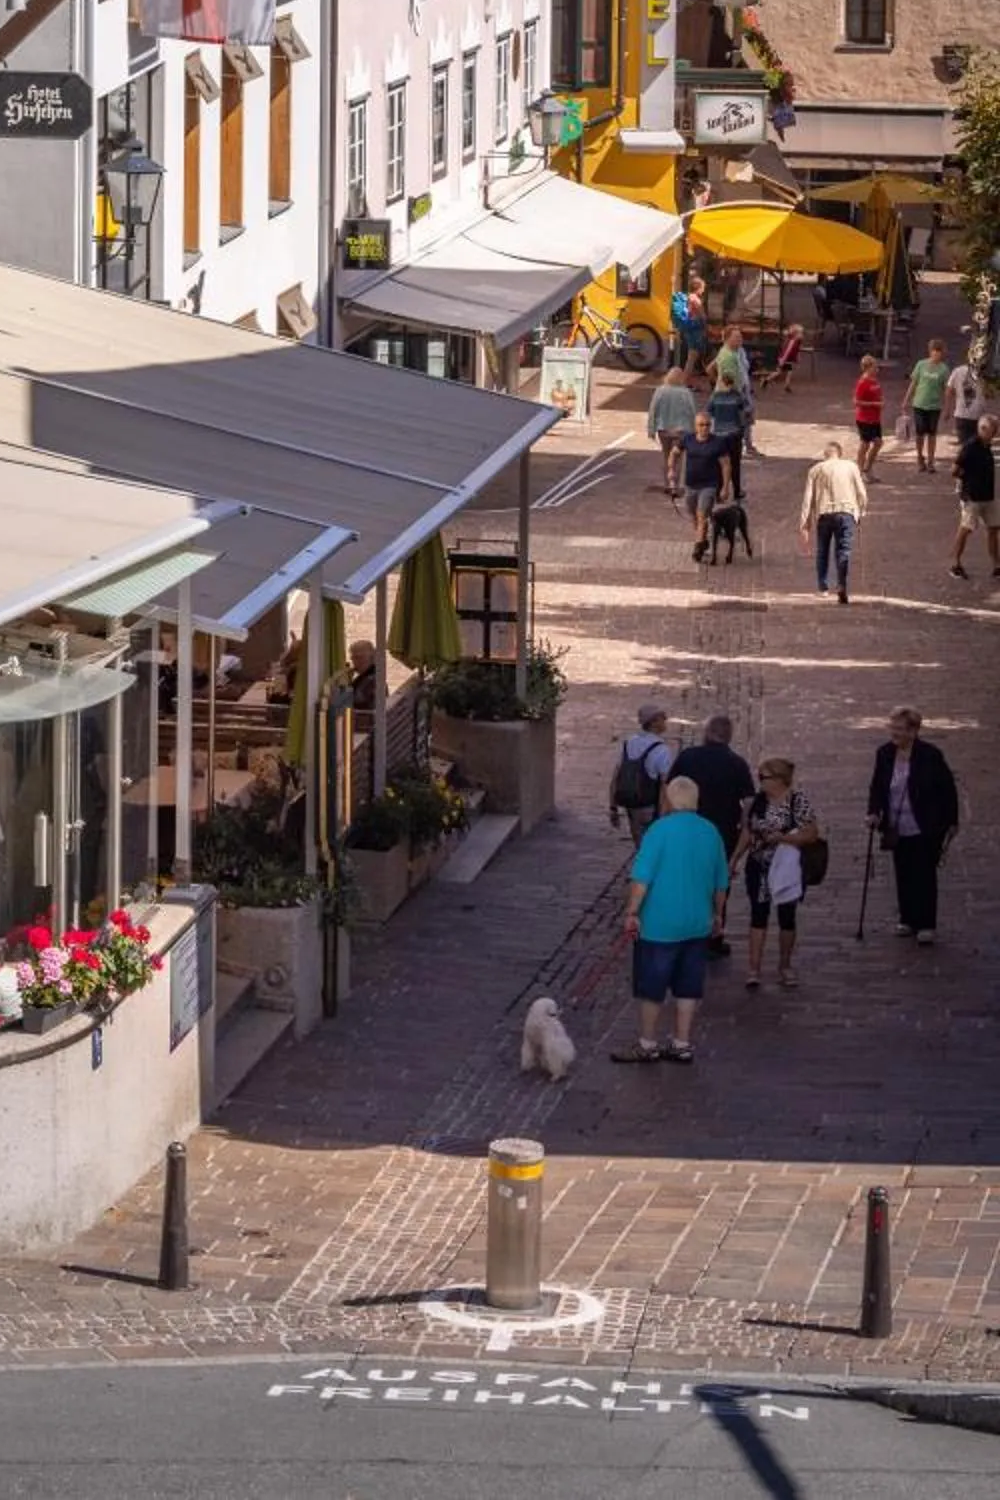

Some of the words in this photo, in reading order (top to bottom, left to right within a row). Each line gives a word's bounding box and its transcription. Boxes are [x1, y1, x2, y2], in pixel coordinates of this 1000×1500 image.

[4, 92, 73, 127] Hirschen
[27, 84, 61, 102] Hotel
[266, 1384, 810, 1421] FREIHALTEN
